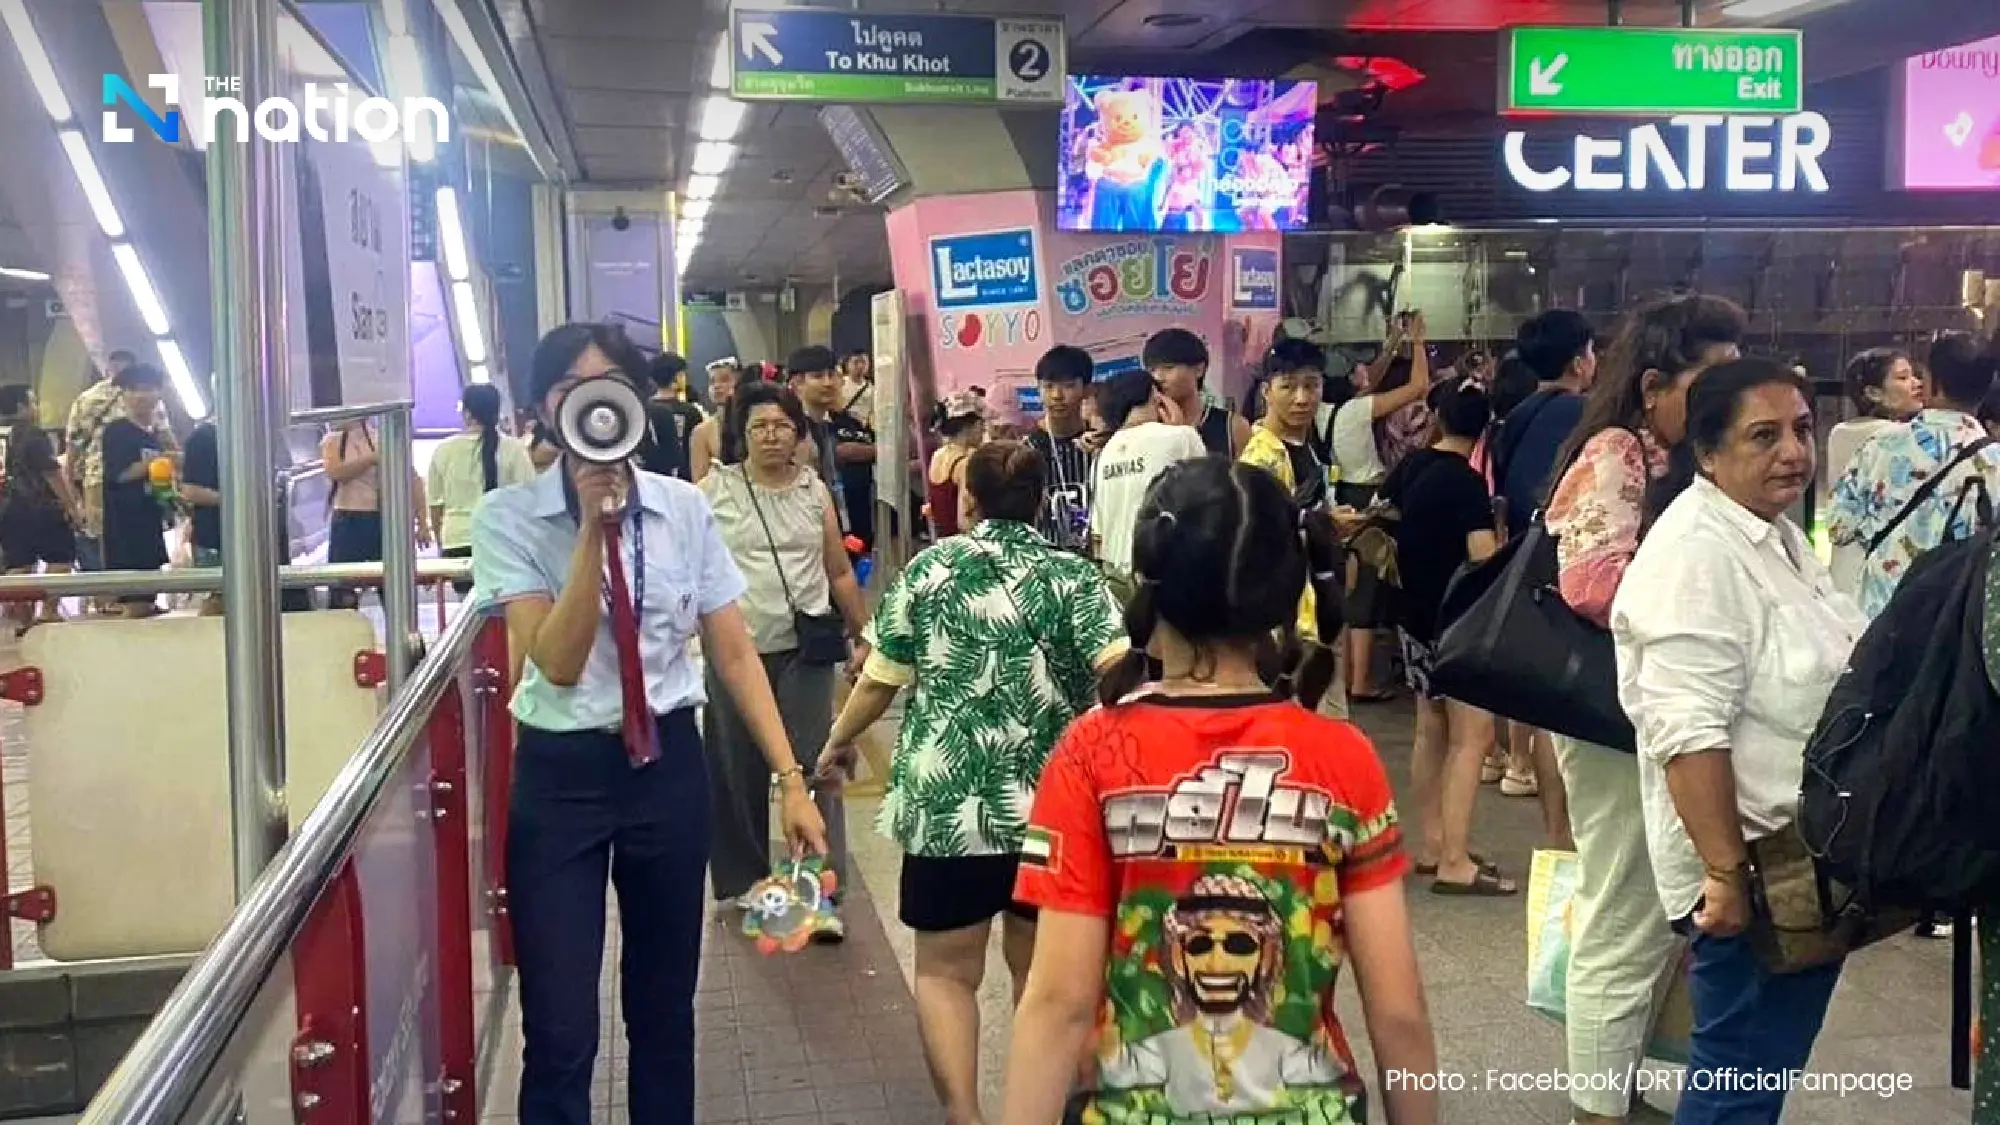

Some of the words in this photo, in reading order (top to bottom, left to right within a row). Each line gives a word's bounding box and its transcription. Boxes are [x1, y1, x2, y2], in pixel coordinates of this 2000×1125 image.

[825, 50, 853, 70] To
[857, 51, 898, 71] Khu
[903, 53, 951, 73] Khot
[1018, 42, 1041, 76] 2
[1672, 43, 1783, 73] ทางออก
[1737, 76, 1783, 99] Exit
[1504, 111, 1832, 192] CENTER
[935, 247, 1030, 299] Lactasoy
[1234, 254, 1276, 301] Lactasoy
